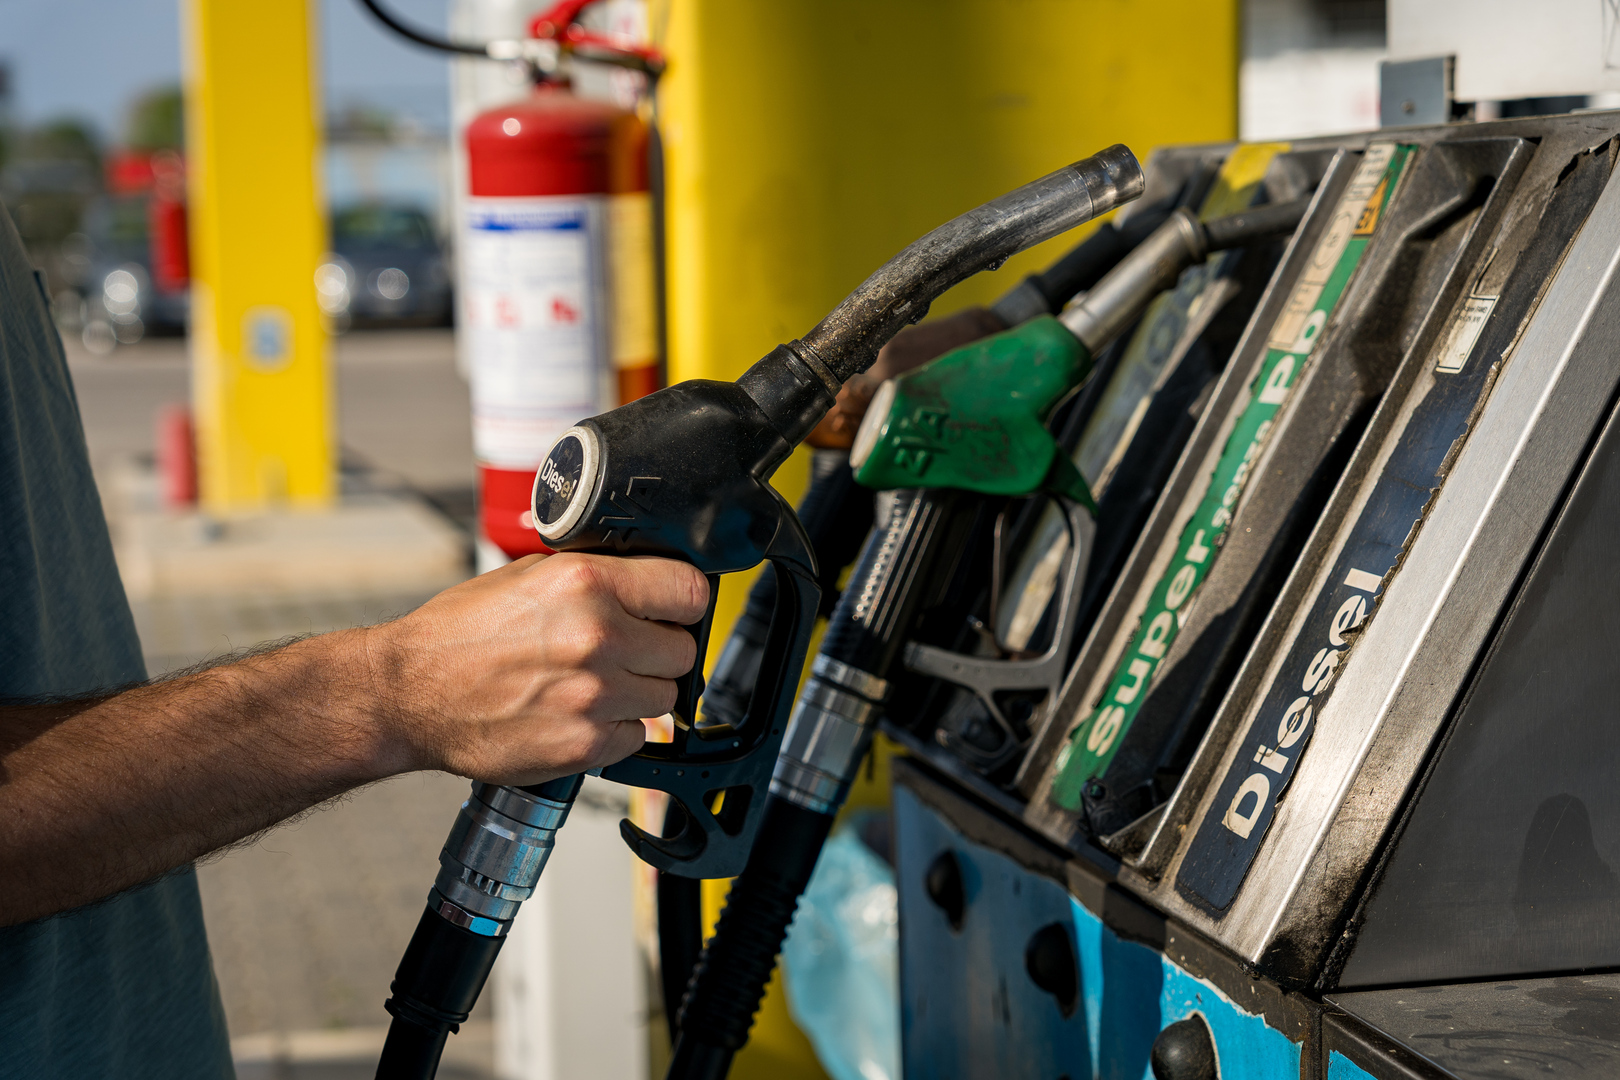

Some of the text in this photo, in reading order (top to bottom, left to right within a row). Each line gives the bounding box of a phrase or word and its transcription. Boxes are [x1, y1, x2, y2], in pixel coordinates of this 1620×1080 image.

[541, 458, 577, 501] Diesel
[1087, 529, 1210, 757] Super
[1258, 309, 1327, 404] Pb
[1221, 568, 1383, 839] Diesel
